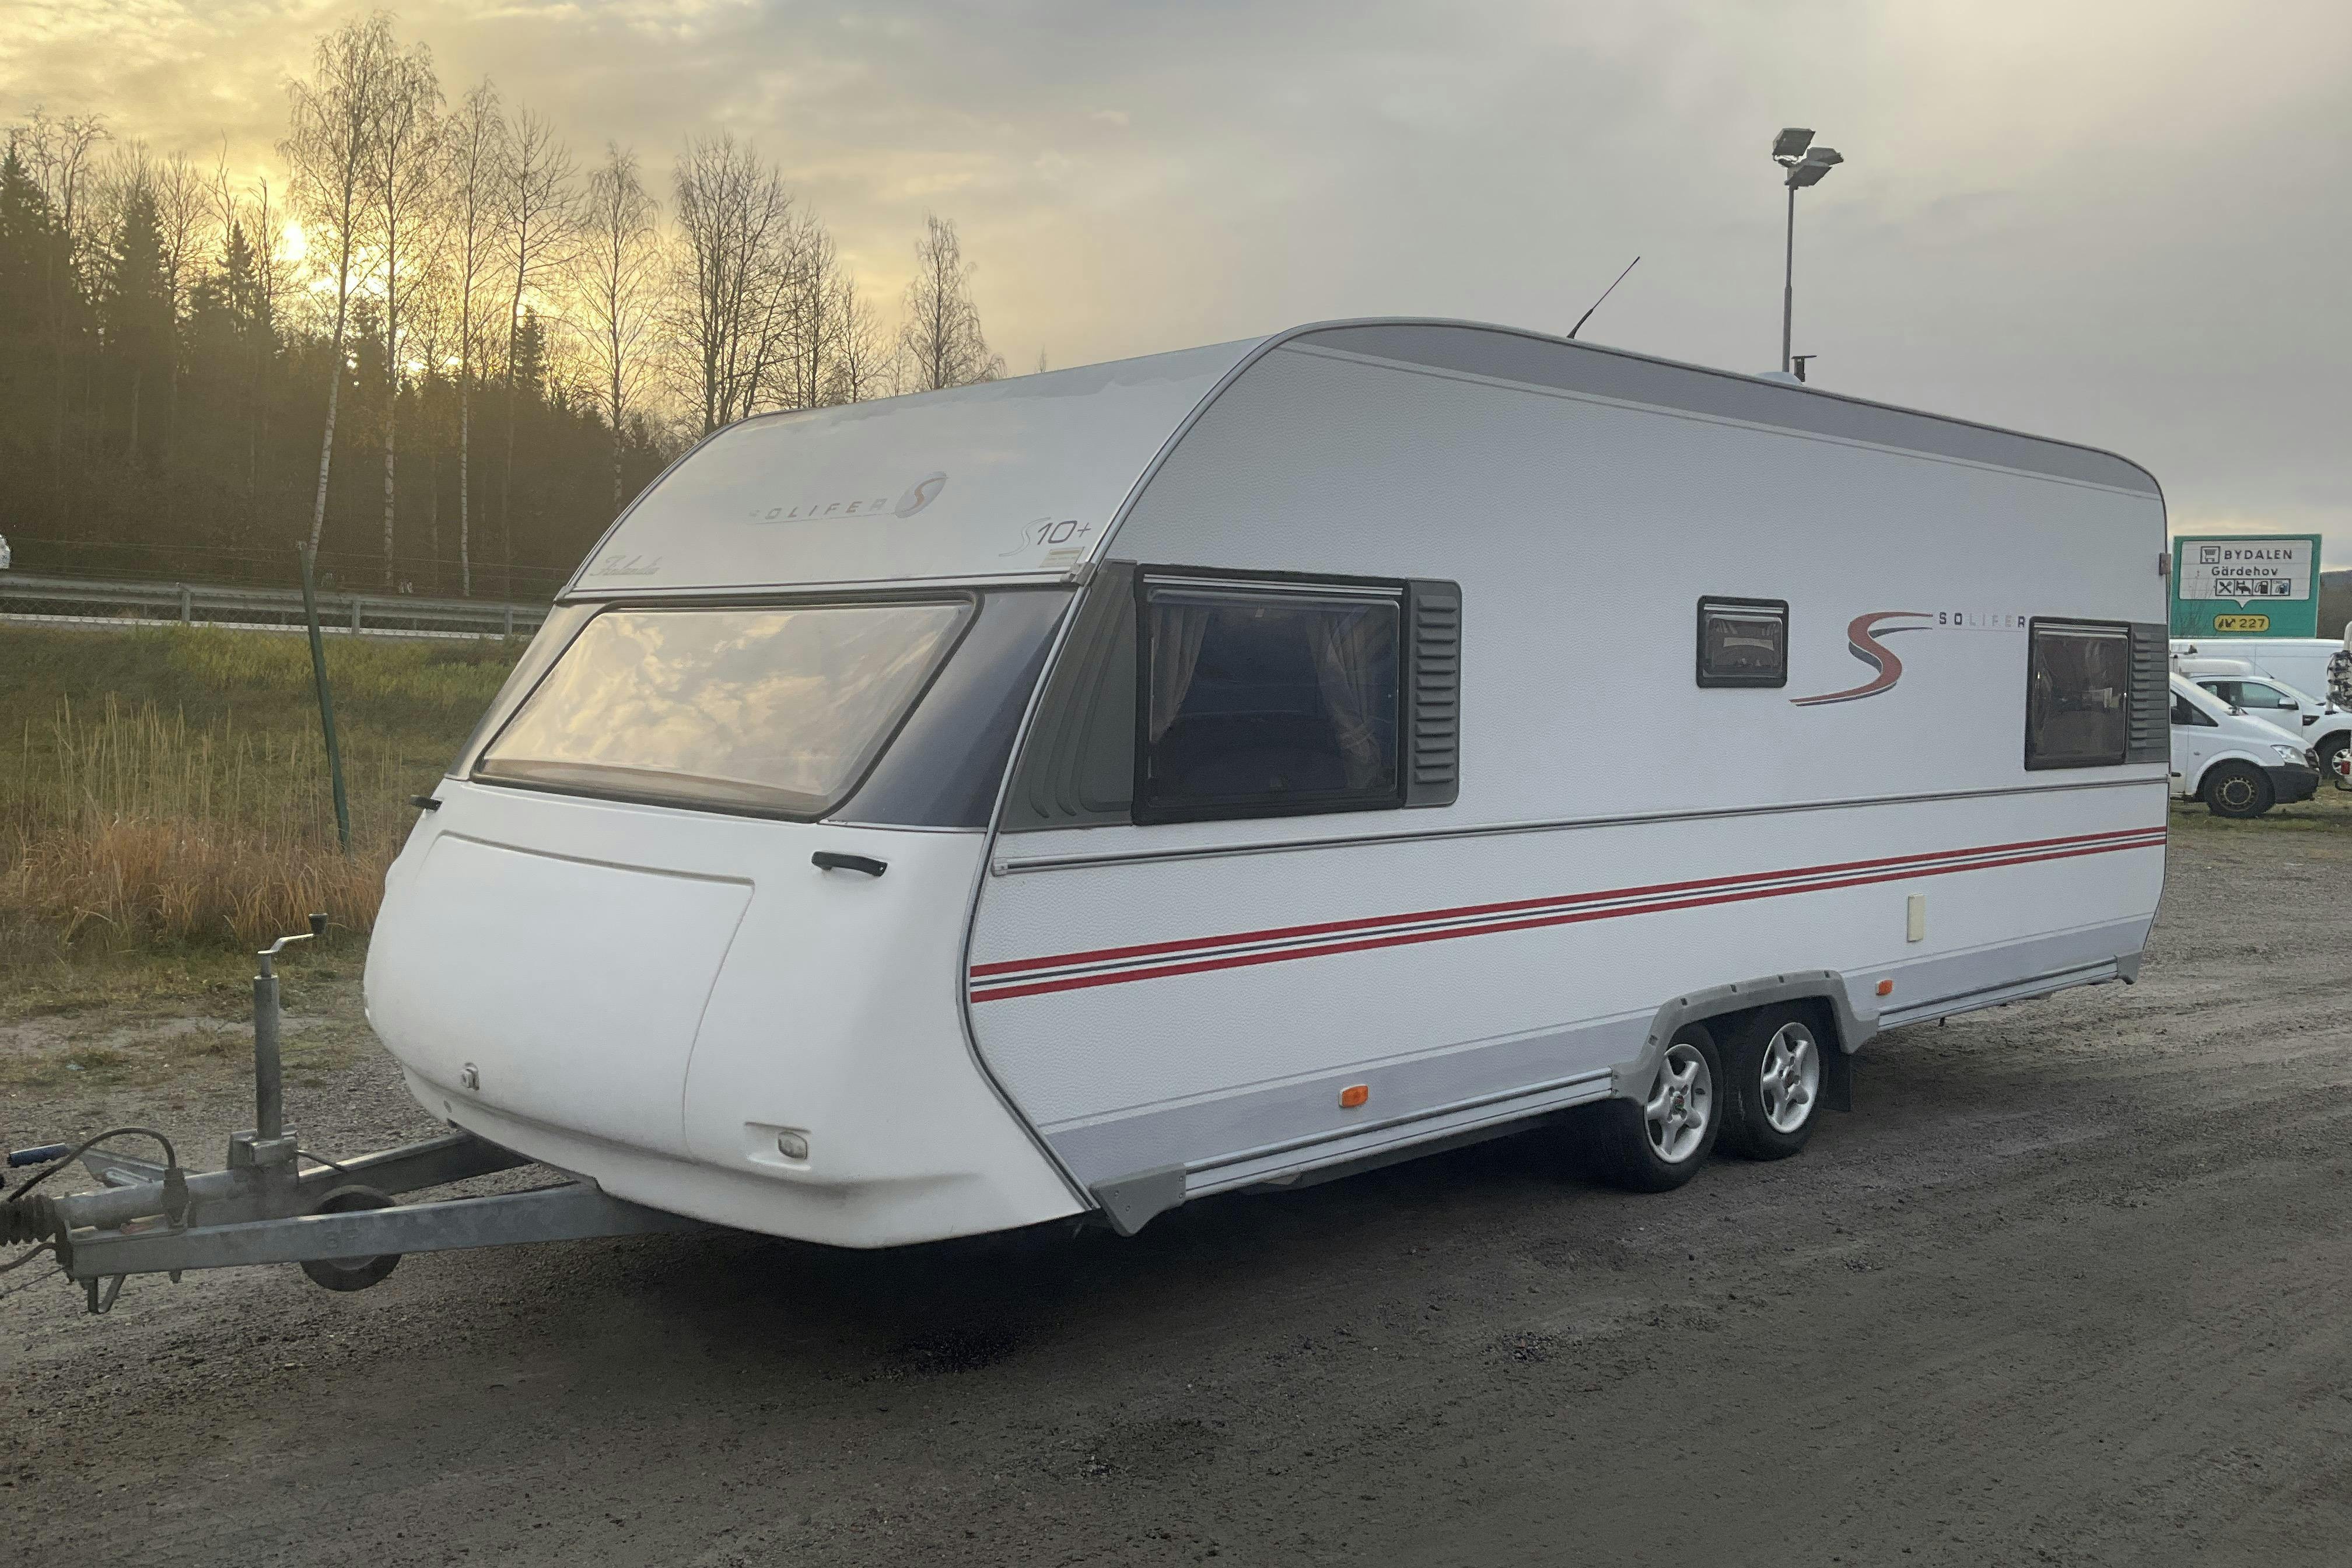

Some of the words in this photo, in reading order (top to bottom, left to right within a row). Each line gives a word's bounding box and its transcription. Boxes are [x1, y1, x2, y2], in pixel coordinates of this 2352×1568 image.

[2224, 550, 2292, 560] BYDALEN
[2211, 566, 2278, 576] Gärdehov
[1939, 611, 2026, 628] SOLIFER
[2239, 618, 2265, 628] 227
